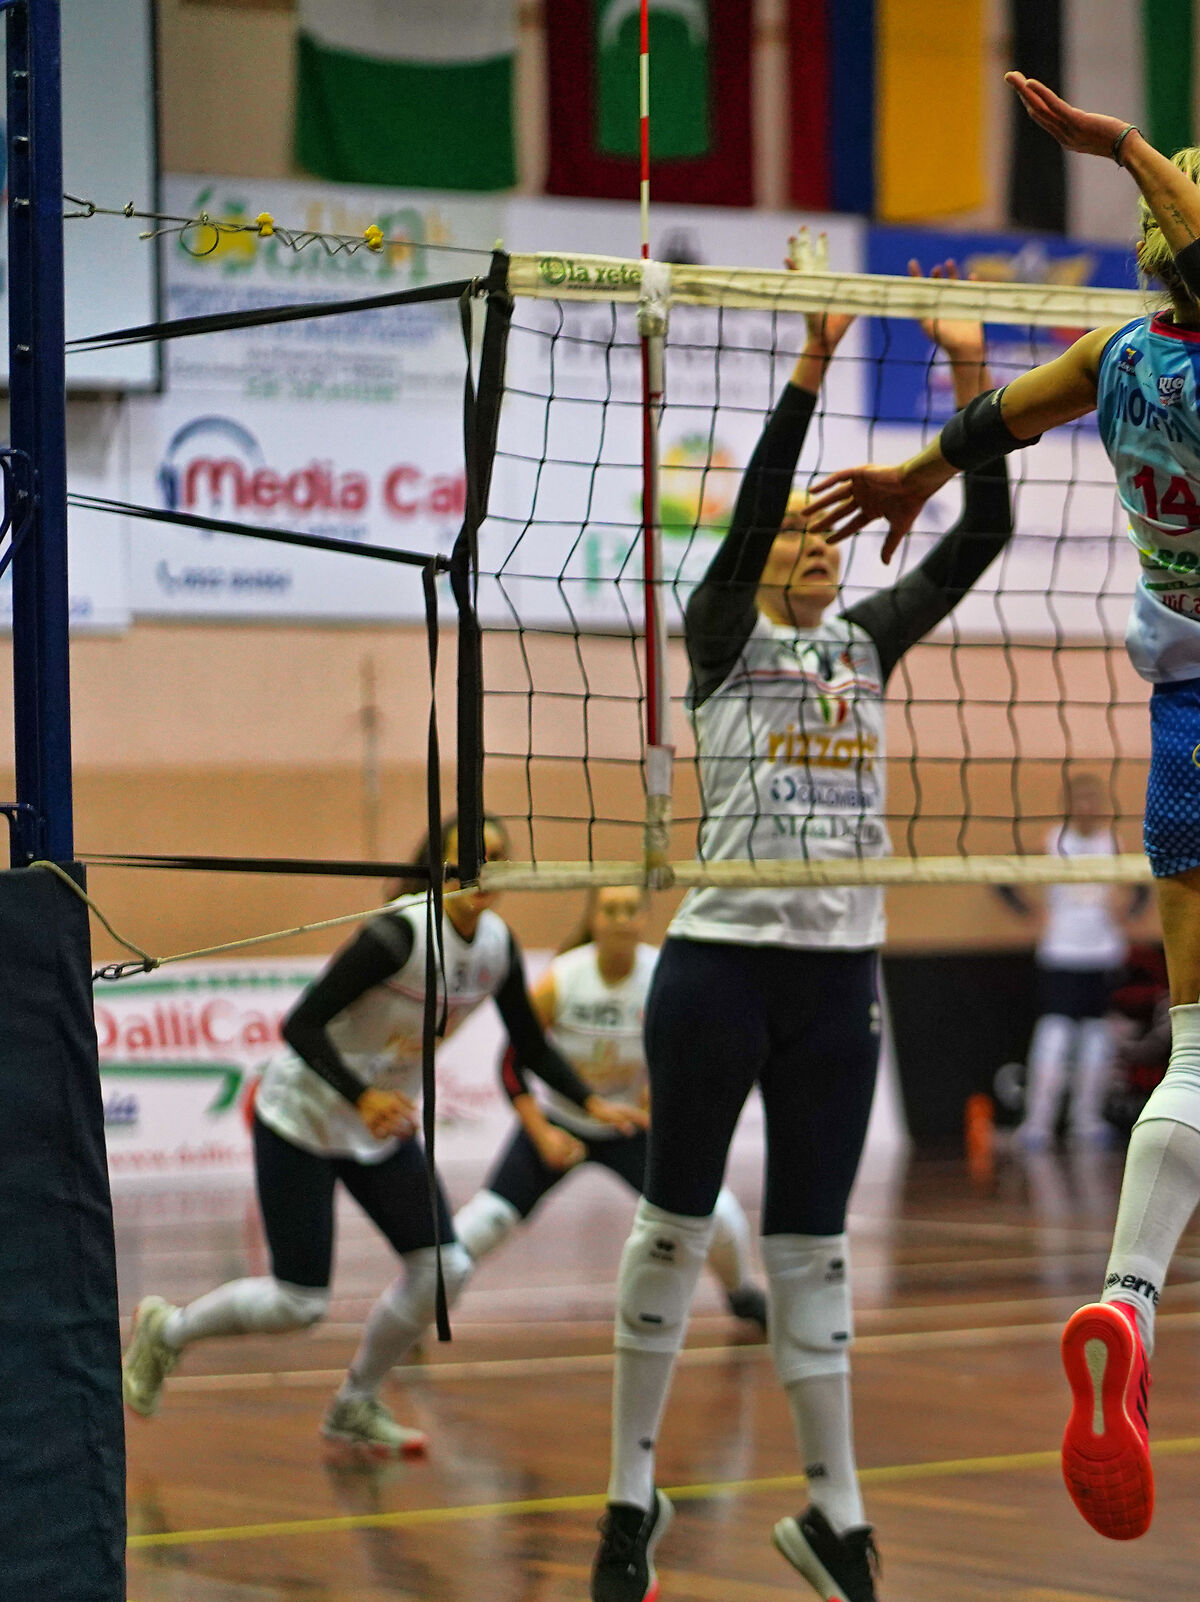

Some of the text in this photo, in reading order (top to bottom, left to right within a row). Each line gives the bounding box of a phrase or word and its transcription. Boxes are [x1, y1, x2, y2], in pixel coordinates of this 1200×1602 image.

[566, 260, 642, 284] la rete
[184, 456, 368, 510] Media
